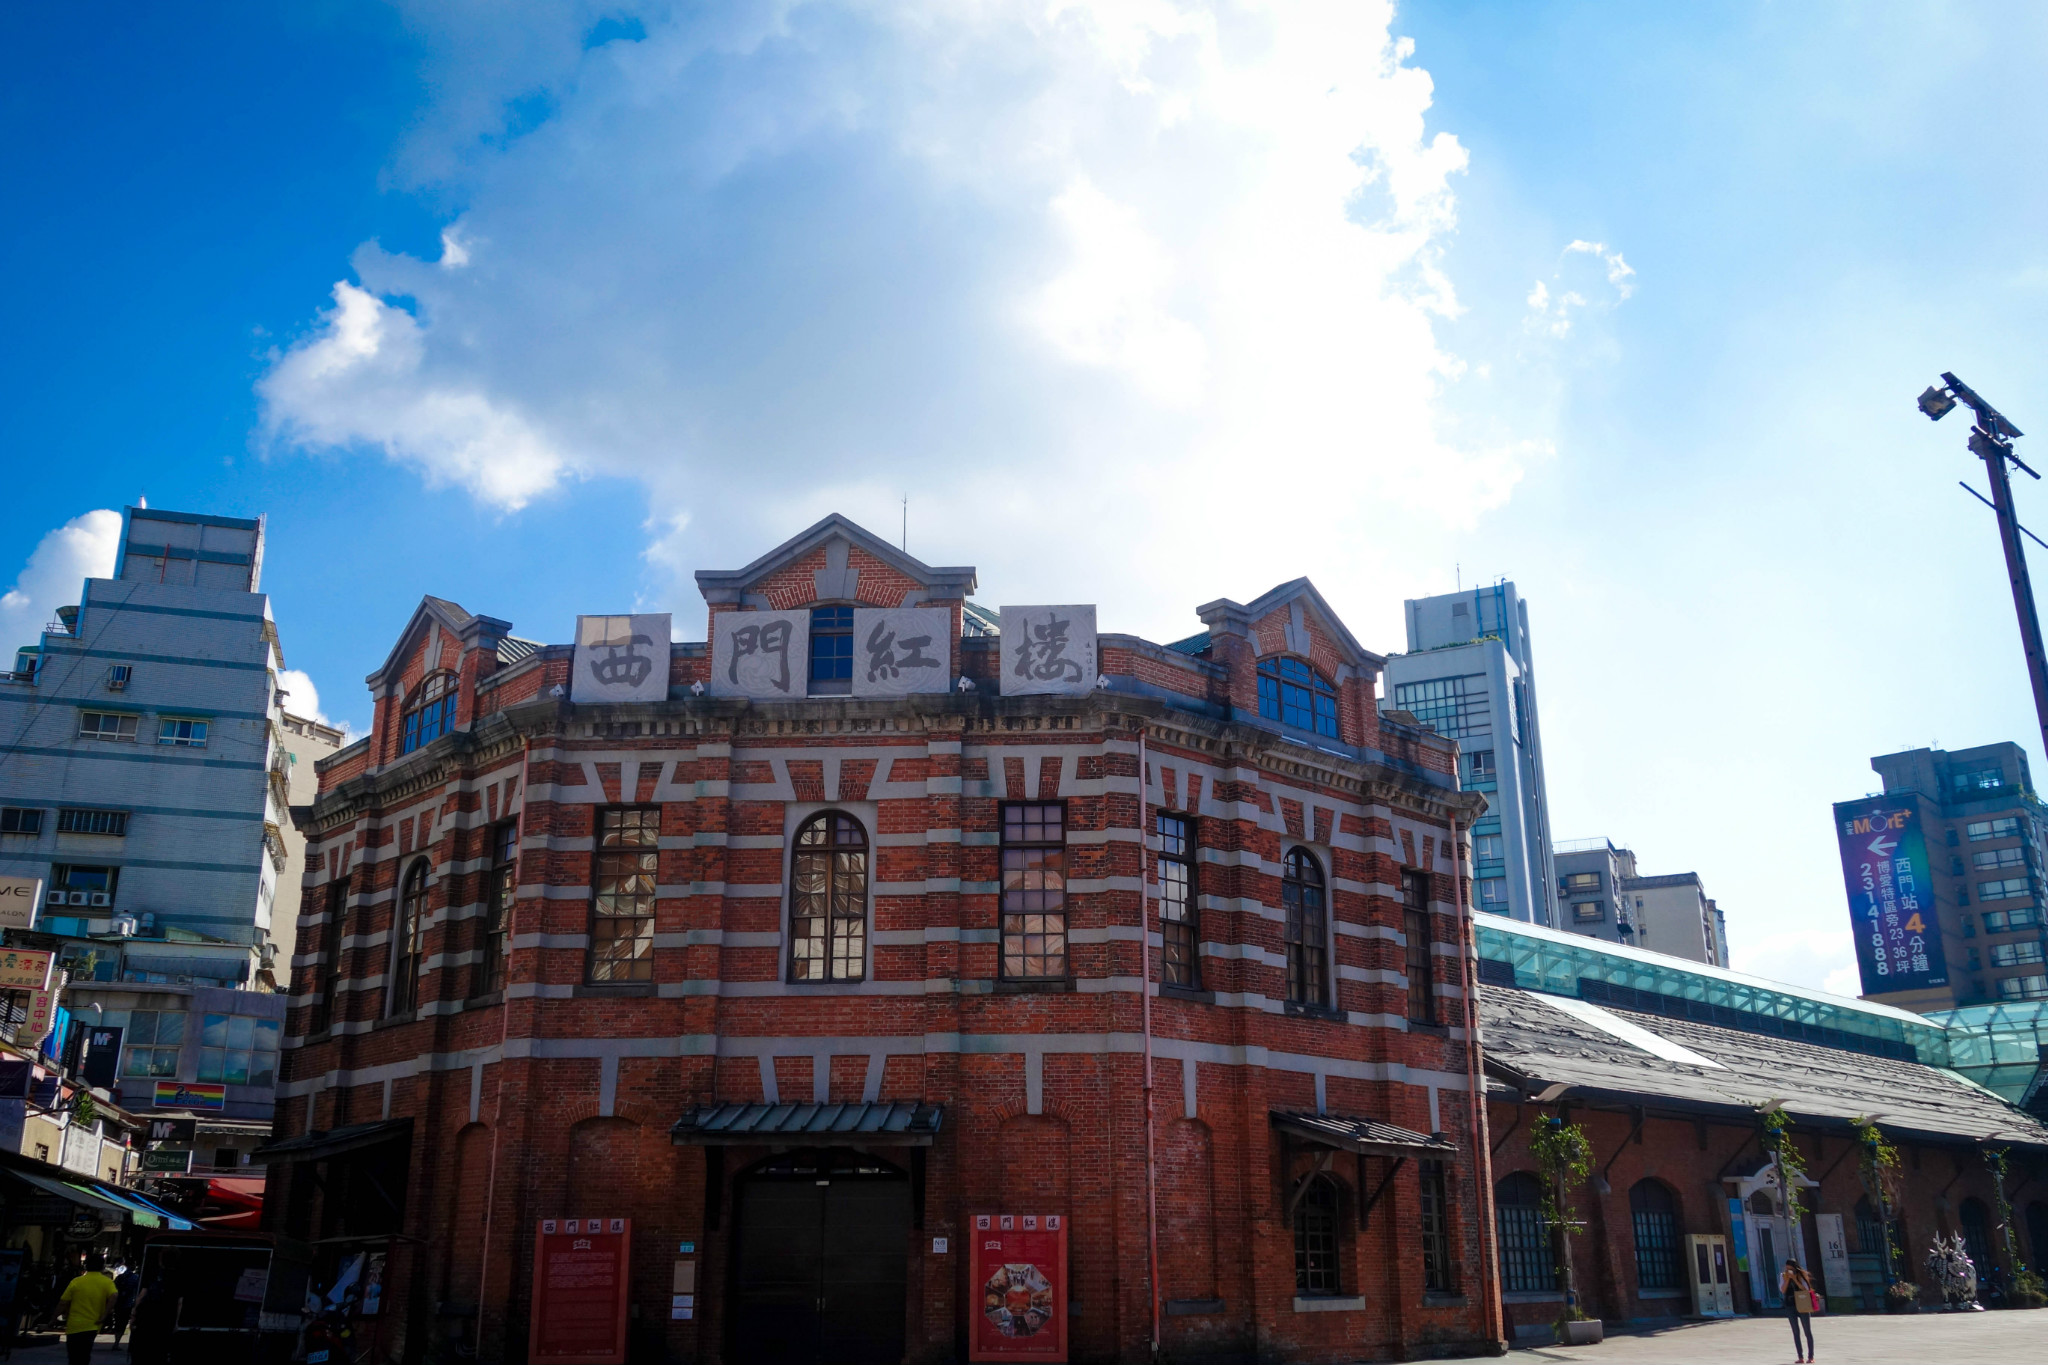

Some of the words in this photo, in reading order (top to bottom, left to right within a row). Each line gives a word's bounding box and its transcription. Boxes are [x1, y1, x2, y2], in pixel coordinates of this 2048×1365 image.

[1860, 863, 1889, 976] 23141888
[1895, 857, 1930, 972] 西門站4分鐘
[1828, 1241, 1839, 1249] 16
